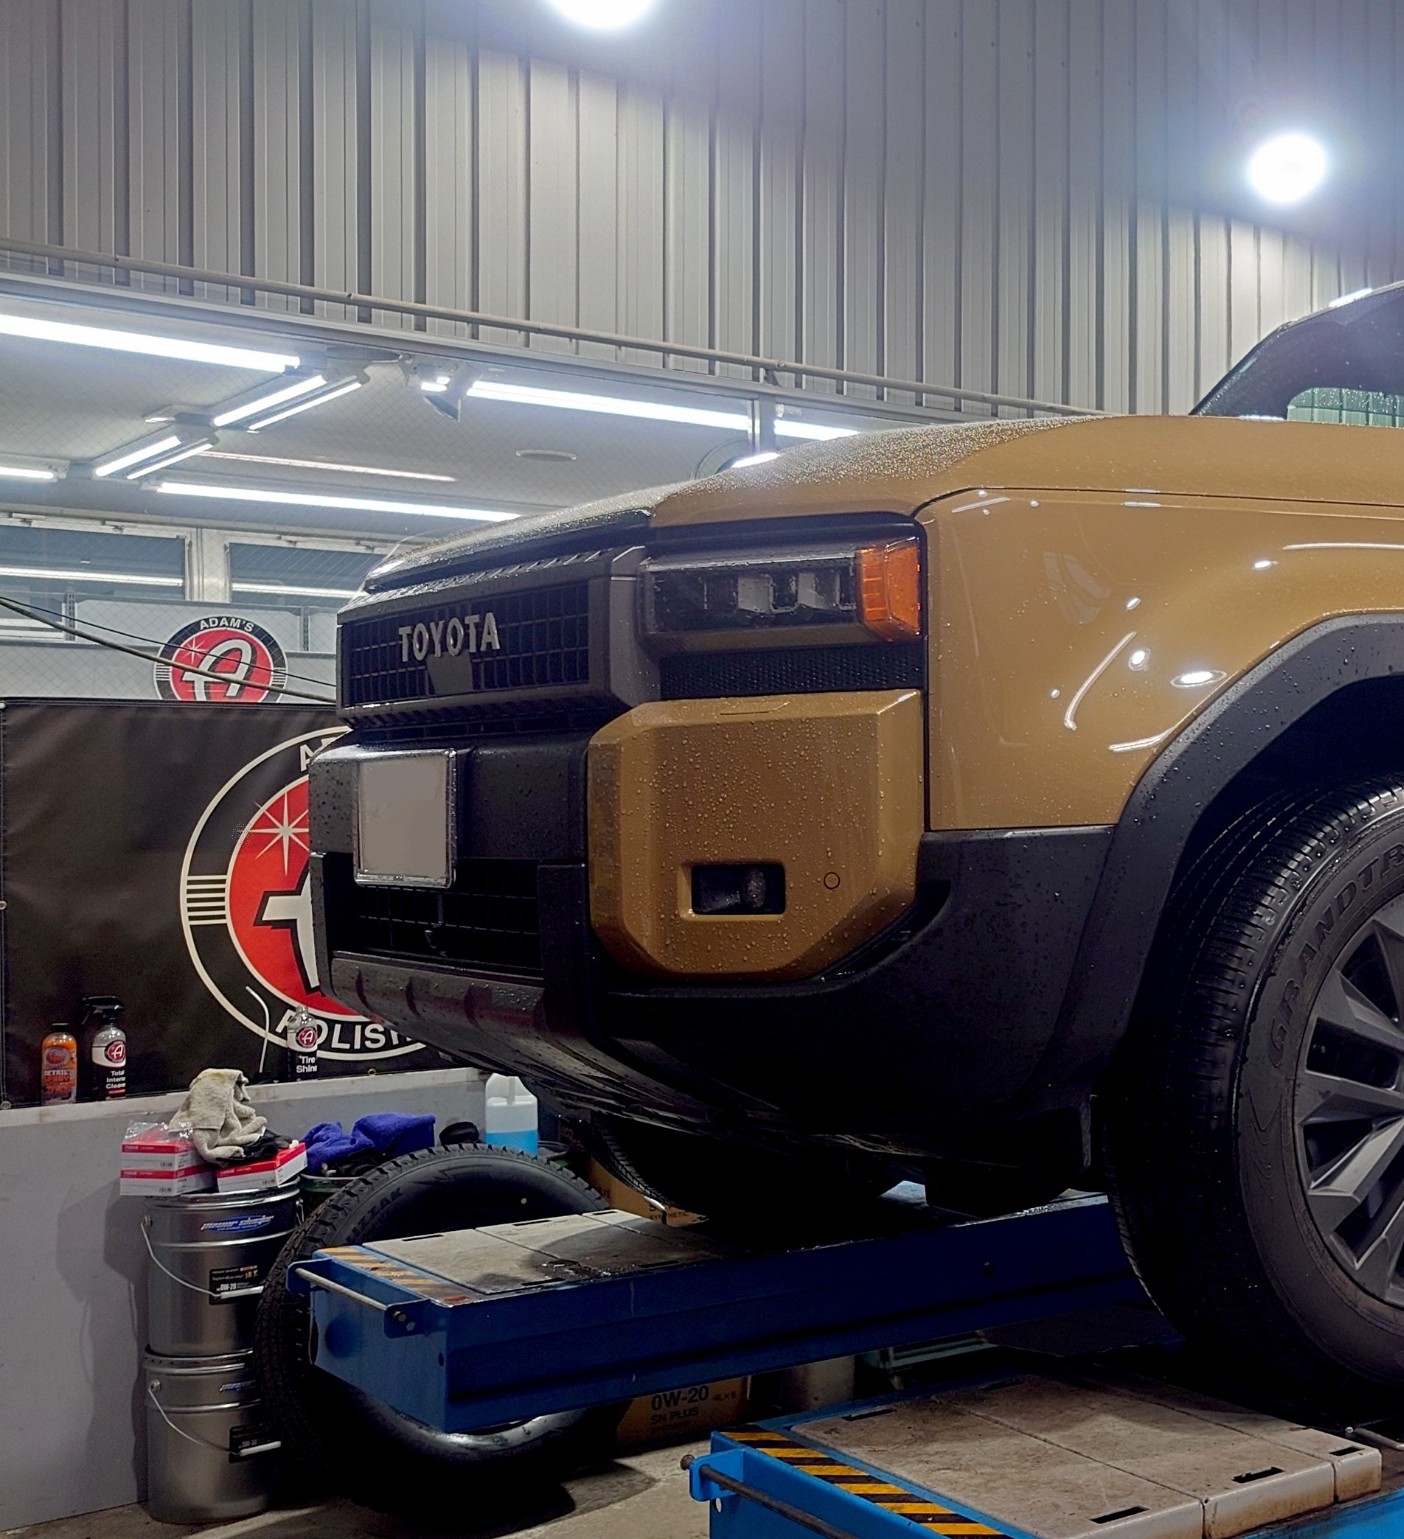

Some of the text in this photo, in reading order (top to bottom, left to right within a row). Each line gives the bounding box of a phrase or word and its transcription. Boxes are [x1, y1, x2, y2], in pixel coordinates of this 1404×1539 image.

[200, 616, 254, 633] ADAM'S
[398, 612, 500, 662] TOYOTA
[299, 1055, 316, 1064] Tire
[110, 1070, 125, 1078] Total
[651, 1385, 710, 1411] 0W-20
[670, 1406, 699, 1420] PLUS
